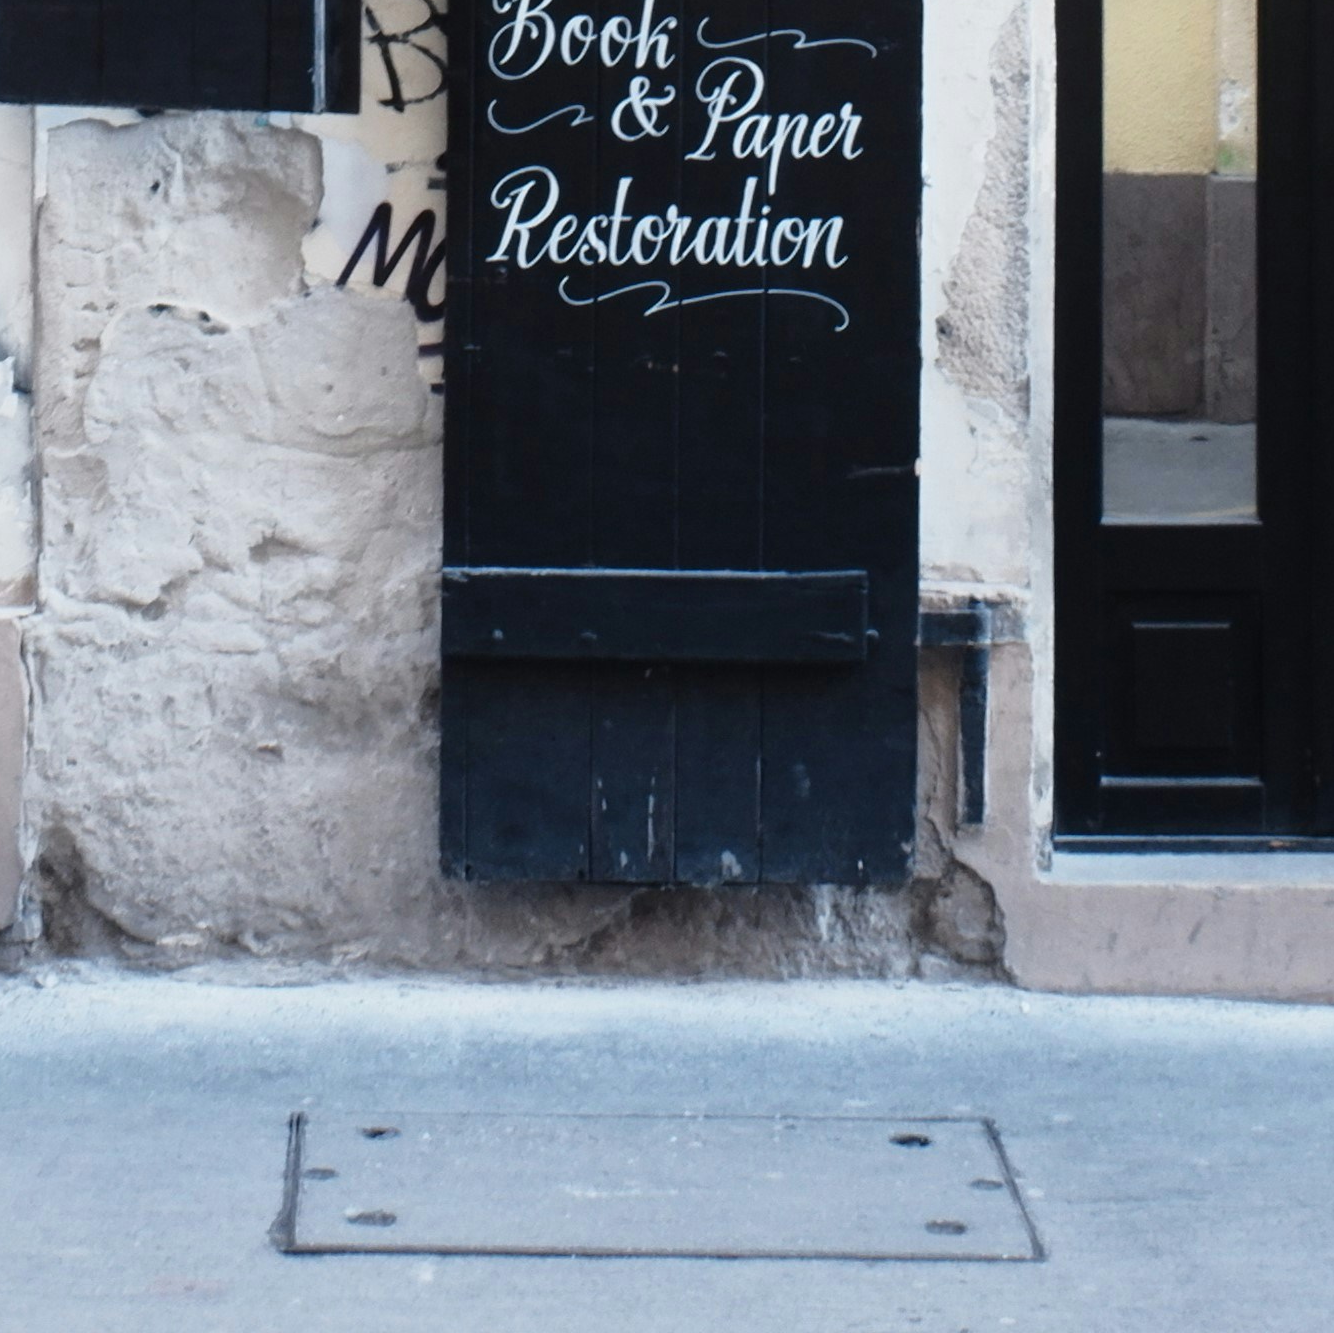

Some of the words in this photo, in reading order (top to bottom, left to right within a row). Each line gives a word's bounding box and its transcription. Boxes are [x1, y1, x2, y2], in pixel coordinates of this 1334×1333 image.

[610, 75, 676, 143] &
[683, 56, 864, 197] Paper
[485, 165, 849, 270] Restoration
